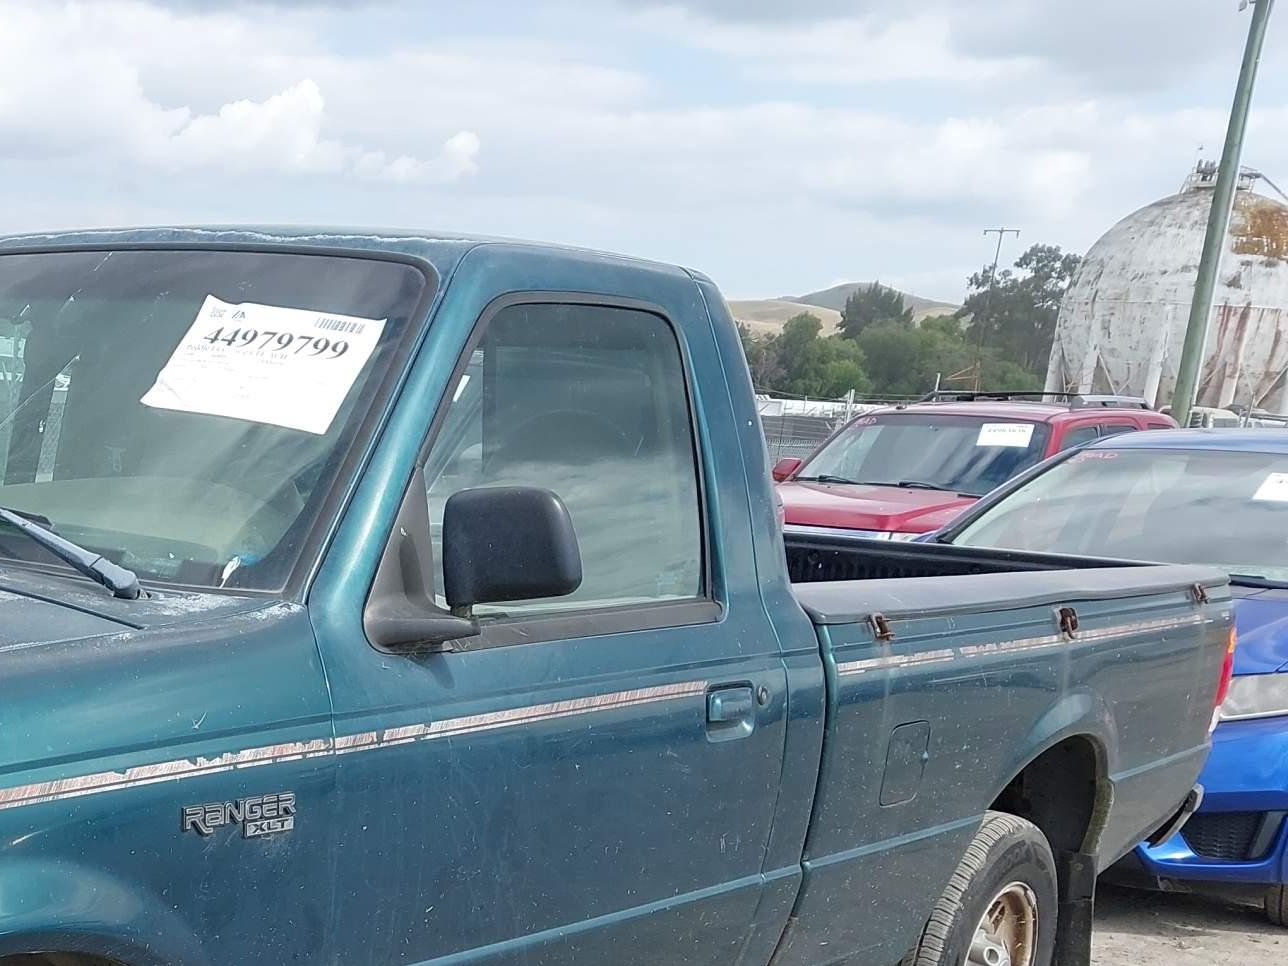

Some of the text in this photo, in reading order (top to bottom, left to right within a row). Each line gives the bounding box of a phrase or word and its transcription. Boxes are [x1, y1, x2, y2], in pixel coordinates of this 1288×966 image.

[204, 326, 349, 359] 44979799
[184, 792, 296, 833] RANGER
[253, 818, 289, 833] XLT
